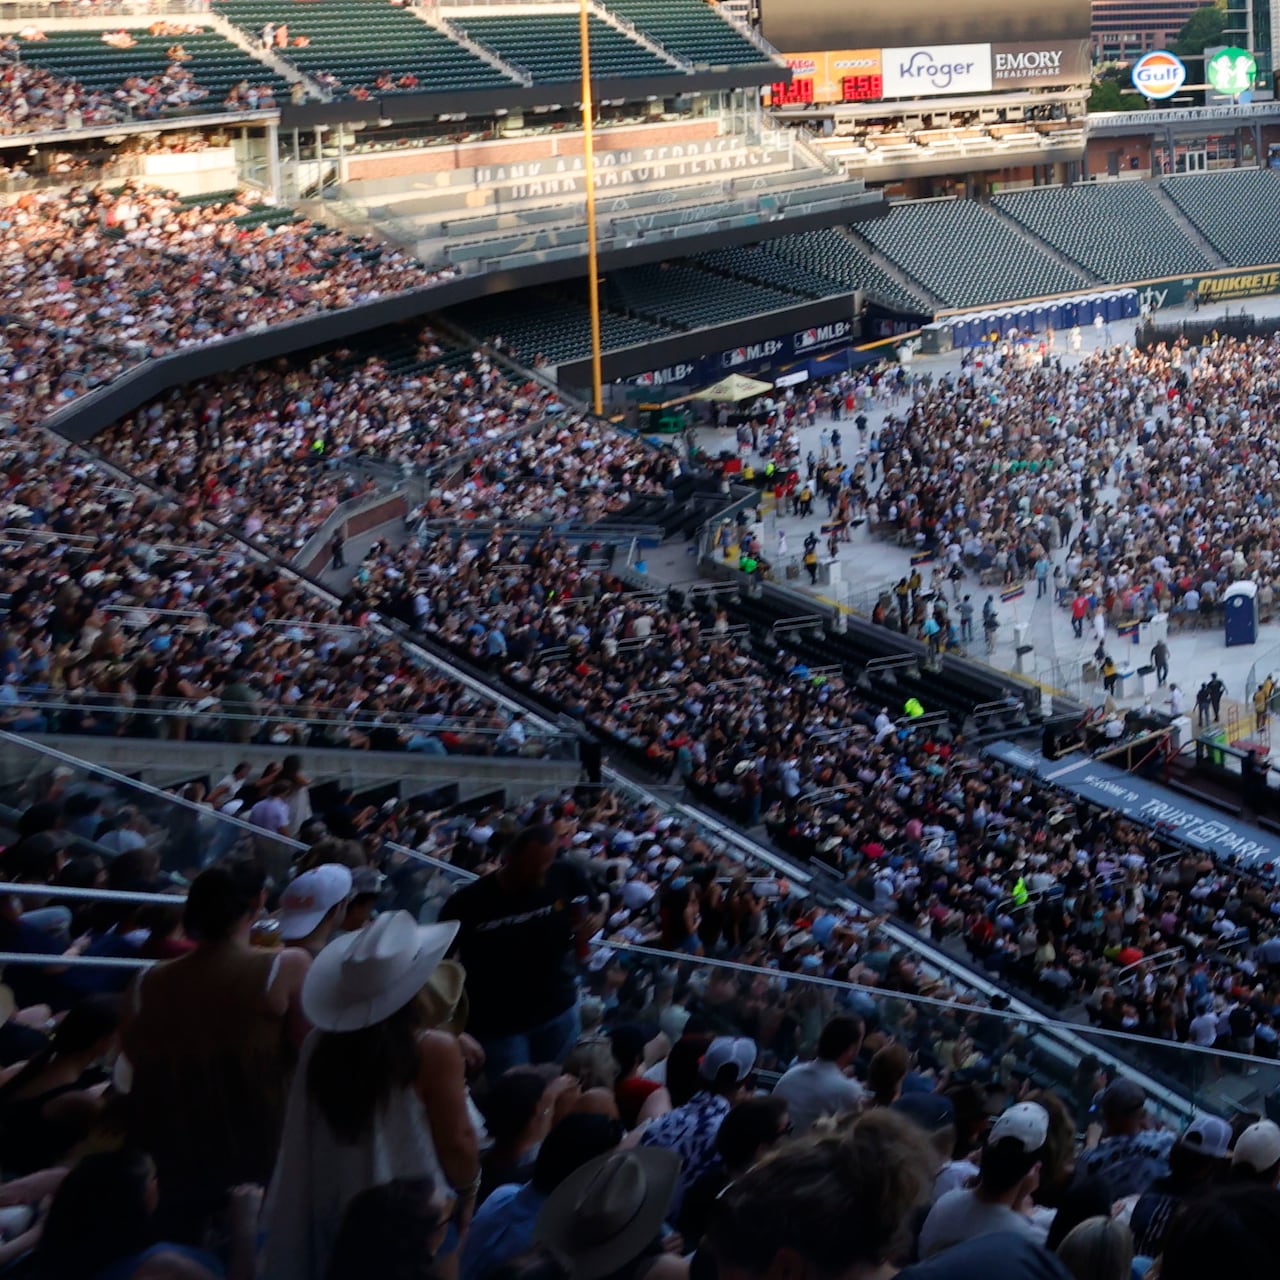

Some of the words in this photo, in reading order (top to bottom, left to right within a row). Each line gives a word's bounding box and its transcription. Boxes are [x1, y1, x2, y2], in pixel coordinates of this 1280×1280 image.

[900, 51, 975, 89] Kroger
[995, 51, 1062, 71] EMORY
[996, 68, 1060, 79] HEALTHCARE
[1137, 67, 1179, 82] Gulf
[1197, 271, 1280, 295] QUIKRETE
[817, 321, 852, 342] MLB+
[745, 339, 784, 361] MLB+
[653, 362, 695, 386] MLB+
[1140, 797, 1202, 830] TRUIST
[1213, 830, 1271, 860] PARK
